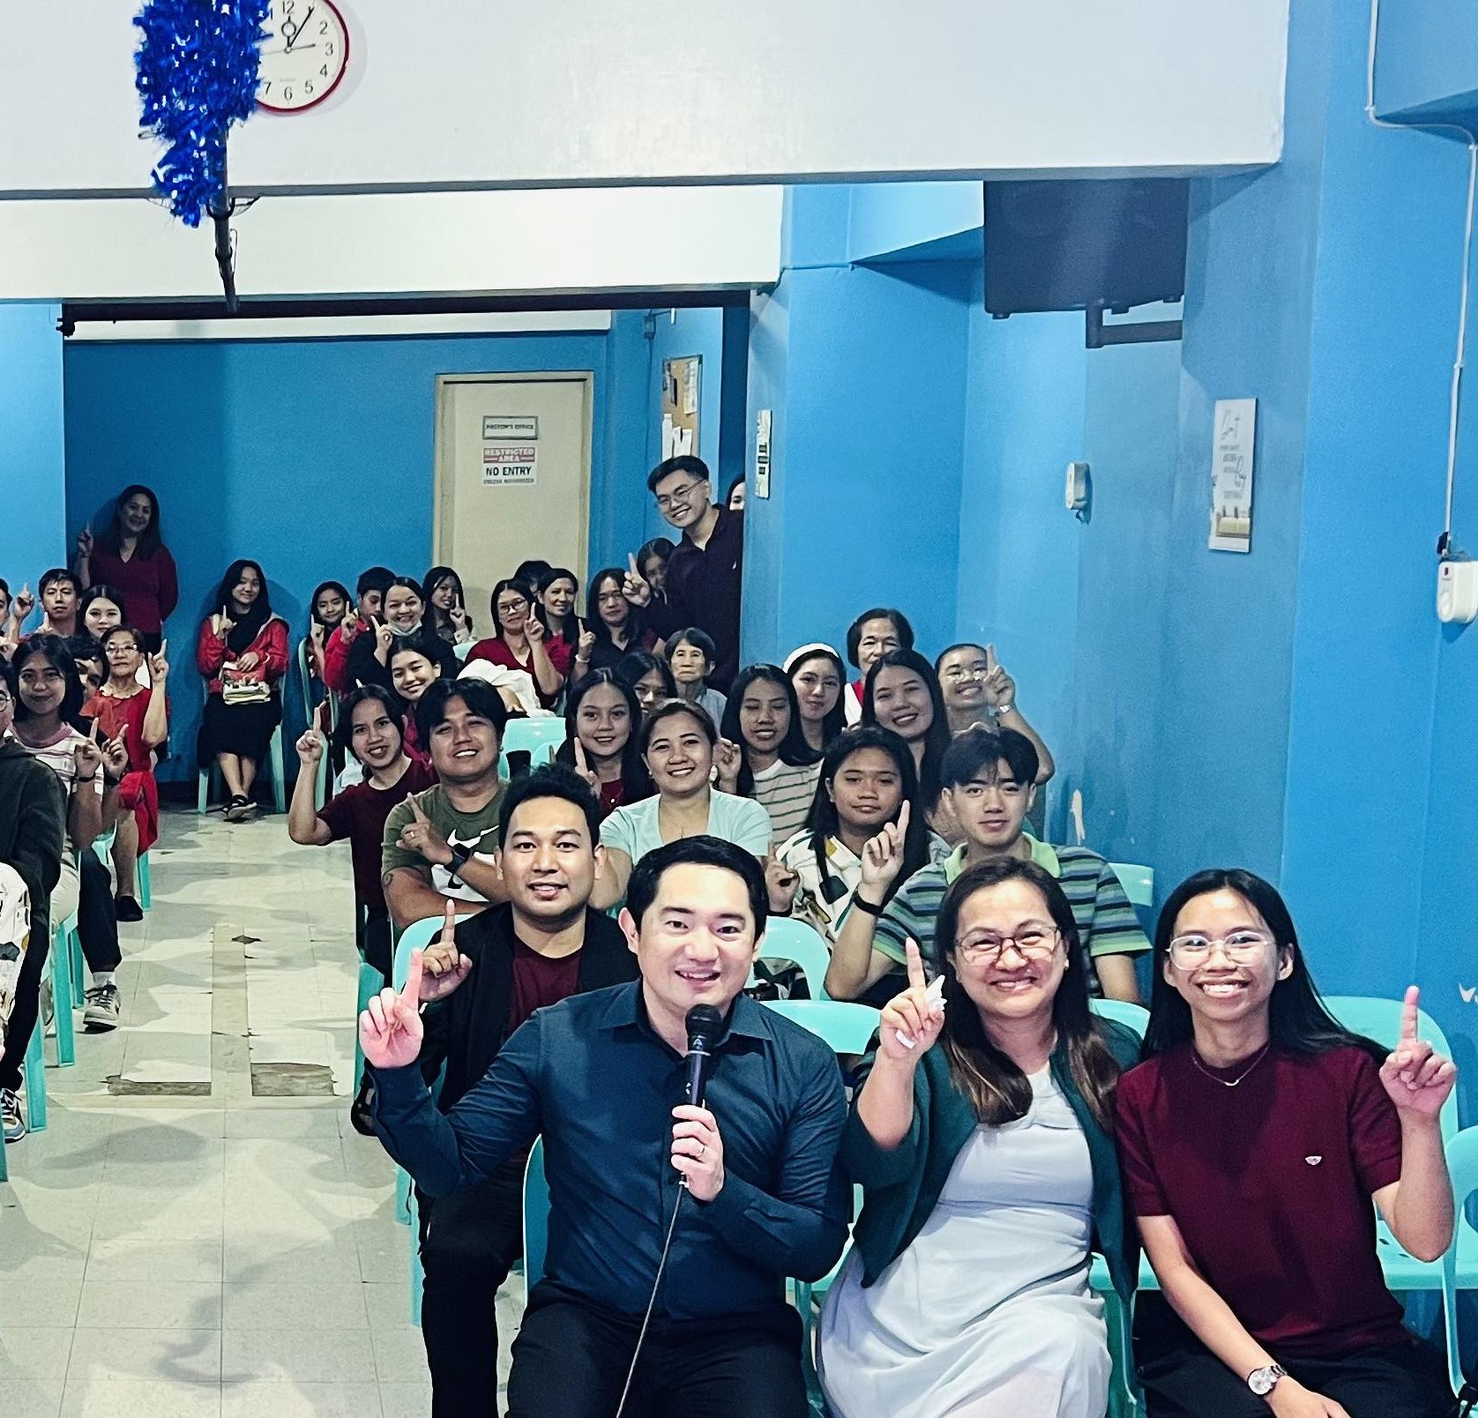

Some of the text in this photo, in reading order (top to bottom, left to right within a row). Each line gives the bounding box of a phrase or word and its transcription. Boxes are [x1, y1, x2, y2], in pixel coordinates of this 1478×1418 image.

[282, 0, 295, 14] 12
[319, 20, 328, 35] 2
[325, 42, 334, 56] 3
[319, 63, 328, 77] 4
[264, 81, 272, 95] 7
[284, 86, 293, 101] 6
[304, 79, 314, 94] 5
[486, 466, 532, 476] NO ENTRY
